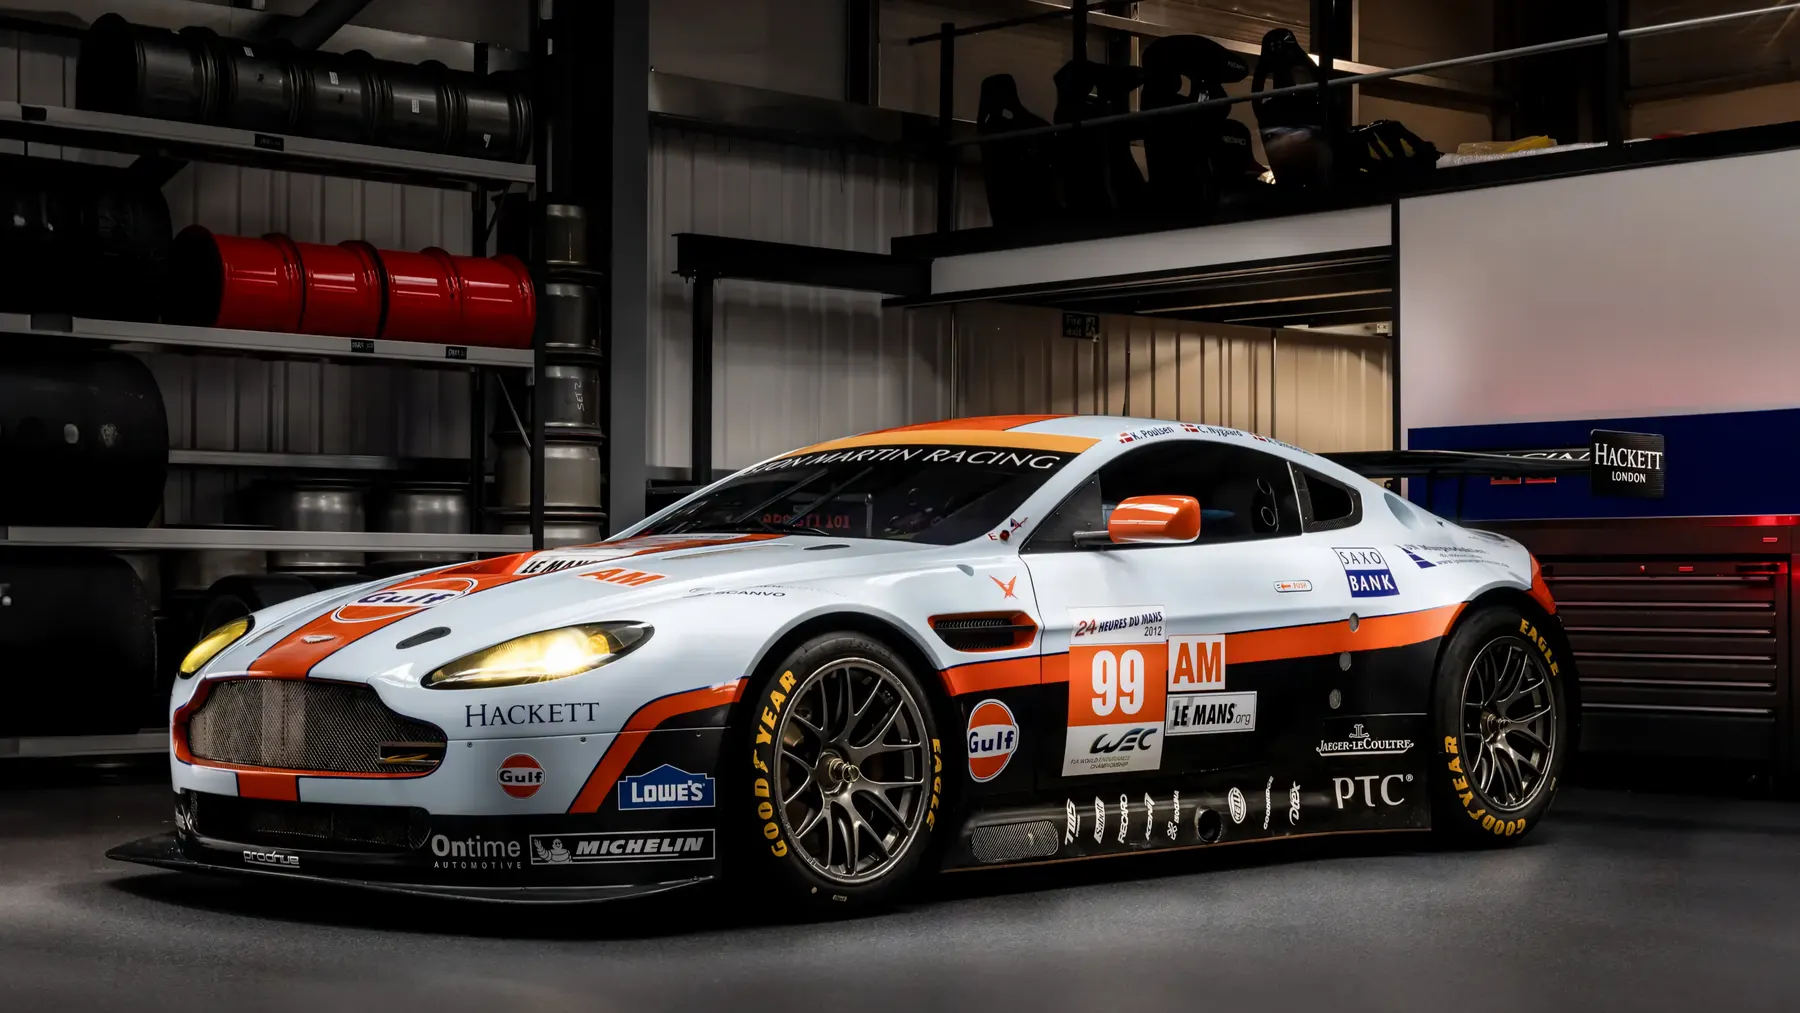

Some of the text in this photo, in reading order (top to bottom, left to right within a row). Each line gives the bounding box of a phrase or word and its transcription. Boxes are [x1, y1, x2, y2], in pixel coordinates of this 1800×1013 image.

[1130, 426, 1175, 440] K. Poulsen
[1197, 425, 1243, 438] C. Nygaard
[805, 448, 923, 465] MARTIN
[922, 449, 1060, 470] RACING
[1593, 442, 1663, 470] HACKETT
[1611, 470, 1646, 484] LONDON
[520, 560, 547, 574] LE
[1339, 551, 1382, 565] SAXO
[578, 568, 667, 588] AM
[1349, 574, 1395, 592] BANK
[357, 591, 456, 605] Gulf
[1074, 611, 1163, 637] 24 HEURES DU MANS
[1144, 626, 1162, 636] 2012
[1518, 618, 1560, 677] EAGLE
[1172, 641, 1222, 685] AM
[1091, 649, 1145, 717] 99
[464, 702, 600, 728] HACKETT
[1173, 704, 1189, 727] LE
[968, 727, 1015, 755] Gulf
[1089, 728, 1158, 754] WEC
[499, 769, 543, 783] Gulf
[926, 738, 943, 832] EAGLE
[631, 779, 704, 803] LOWE'S
[1263, 775, 1274, 831] GOODRIDGE
[1095, 801, 1104, 840] Sabelt
[1117, 793, 1129, 844] RECARO
[1144, 792, 1156, 841] KONI
[430, 834, 521, 857] Ontime
[575, 836, 704, 855] MICHELIN
[243, 850, 300, 865] prodrive
[433, 860, 522, 870] AUTOMOTIVE
